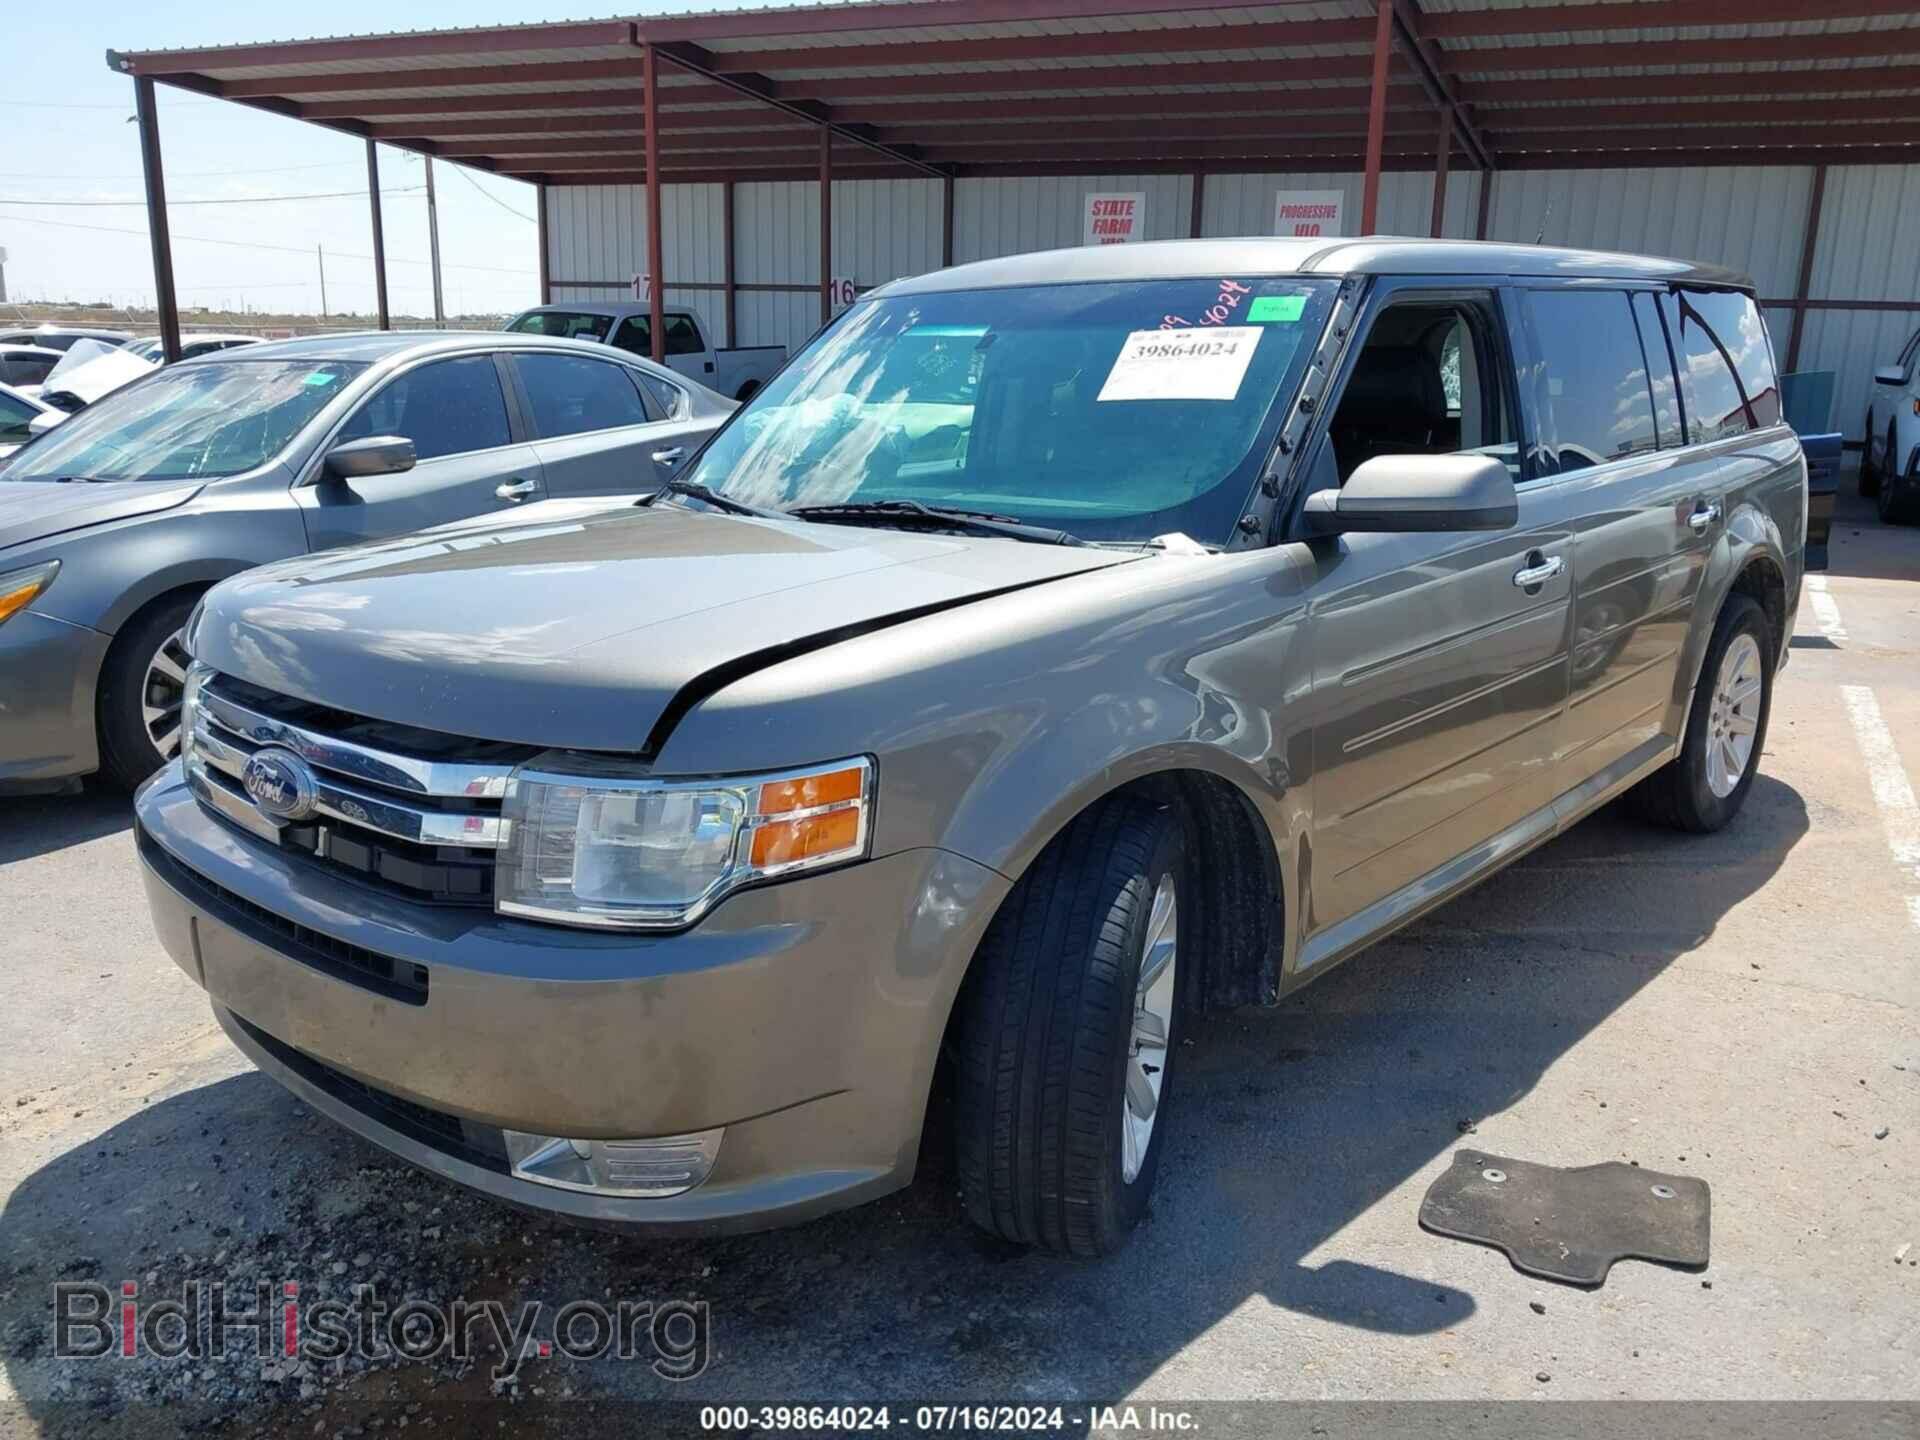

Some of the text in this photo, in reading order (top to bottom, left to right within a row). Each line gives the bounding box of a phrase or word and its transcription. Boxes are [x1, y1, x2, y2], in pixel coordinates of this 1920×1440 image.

[1092, 200, 1136, 216] STATE
[1280, 204, 1337, 219] PROGRESSIVE
[1092, 219, 1132, 234] FARM
[830, 279, 854, 305] 16
[1199, 279, 1251, 325] 4024
[1131, 342, 1238, 360] 39864024
[248, 762, 287, 804] Ford
